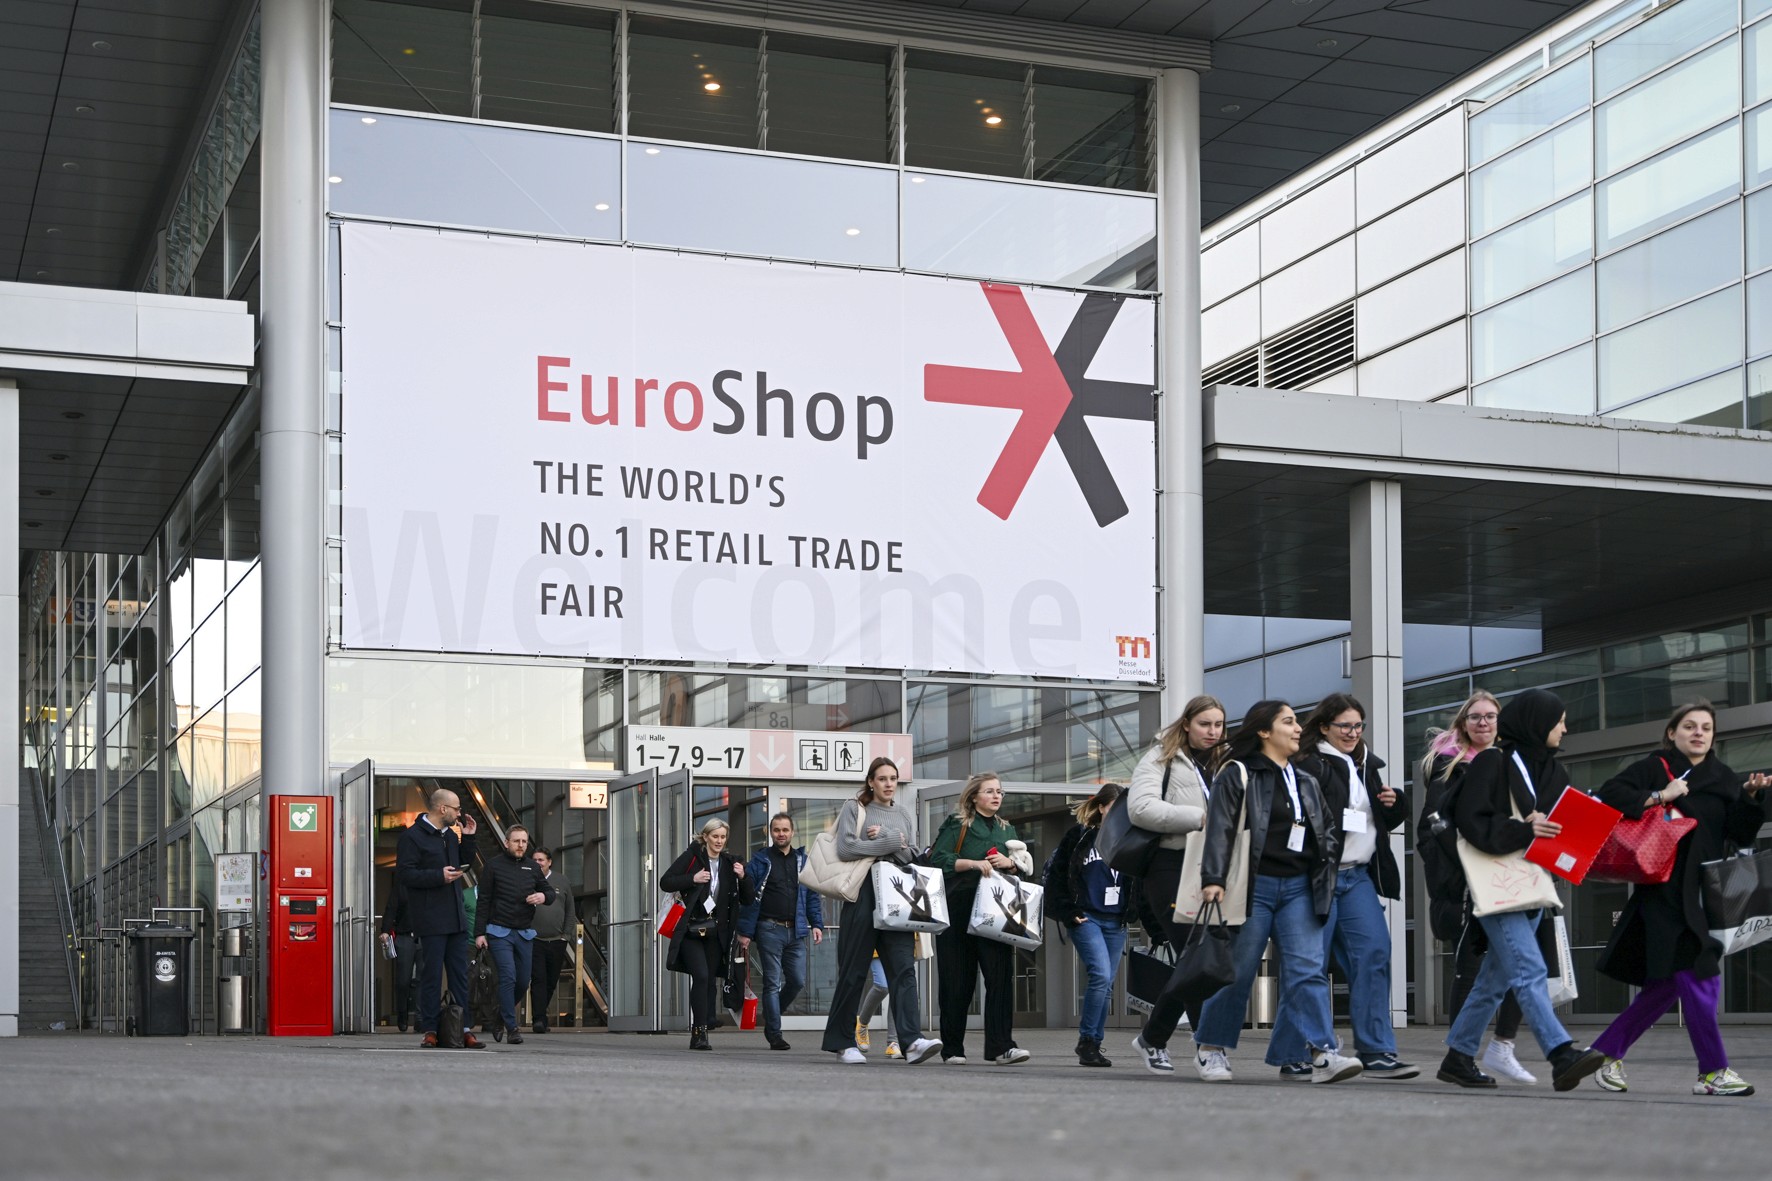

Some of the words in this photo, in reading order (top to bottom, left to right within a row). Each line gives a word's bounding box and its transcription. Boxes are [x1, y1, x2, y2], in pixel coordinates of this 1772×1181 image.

[536, 356, 893, 460] EuroShop
[534, 461, 603, 496] THE
[620, 466, 785, 507] WORLD'S
[650, 528, 773, 565] RETAIL
[788, 535, 903, 573] TRADE
[342, 506, 1082, 676] Welcome
[541, 583, 623, 618] FAIR
[1118, 668, 1151, 676] Düsseldorf
[635, 733, 647, 741] Hall
[649, 734, 666, 742] Halle
[769, 711, 789, 728] 8a
